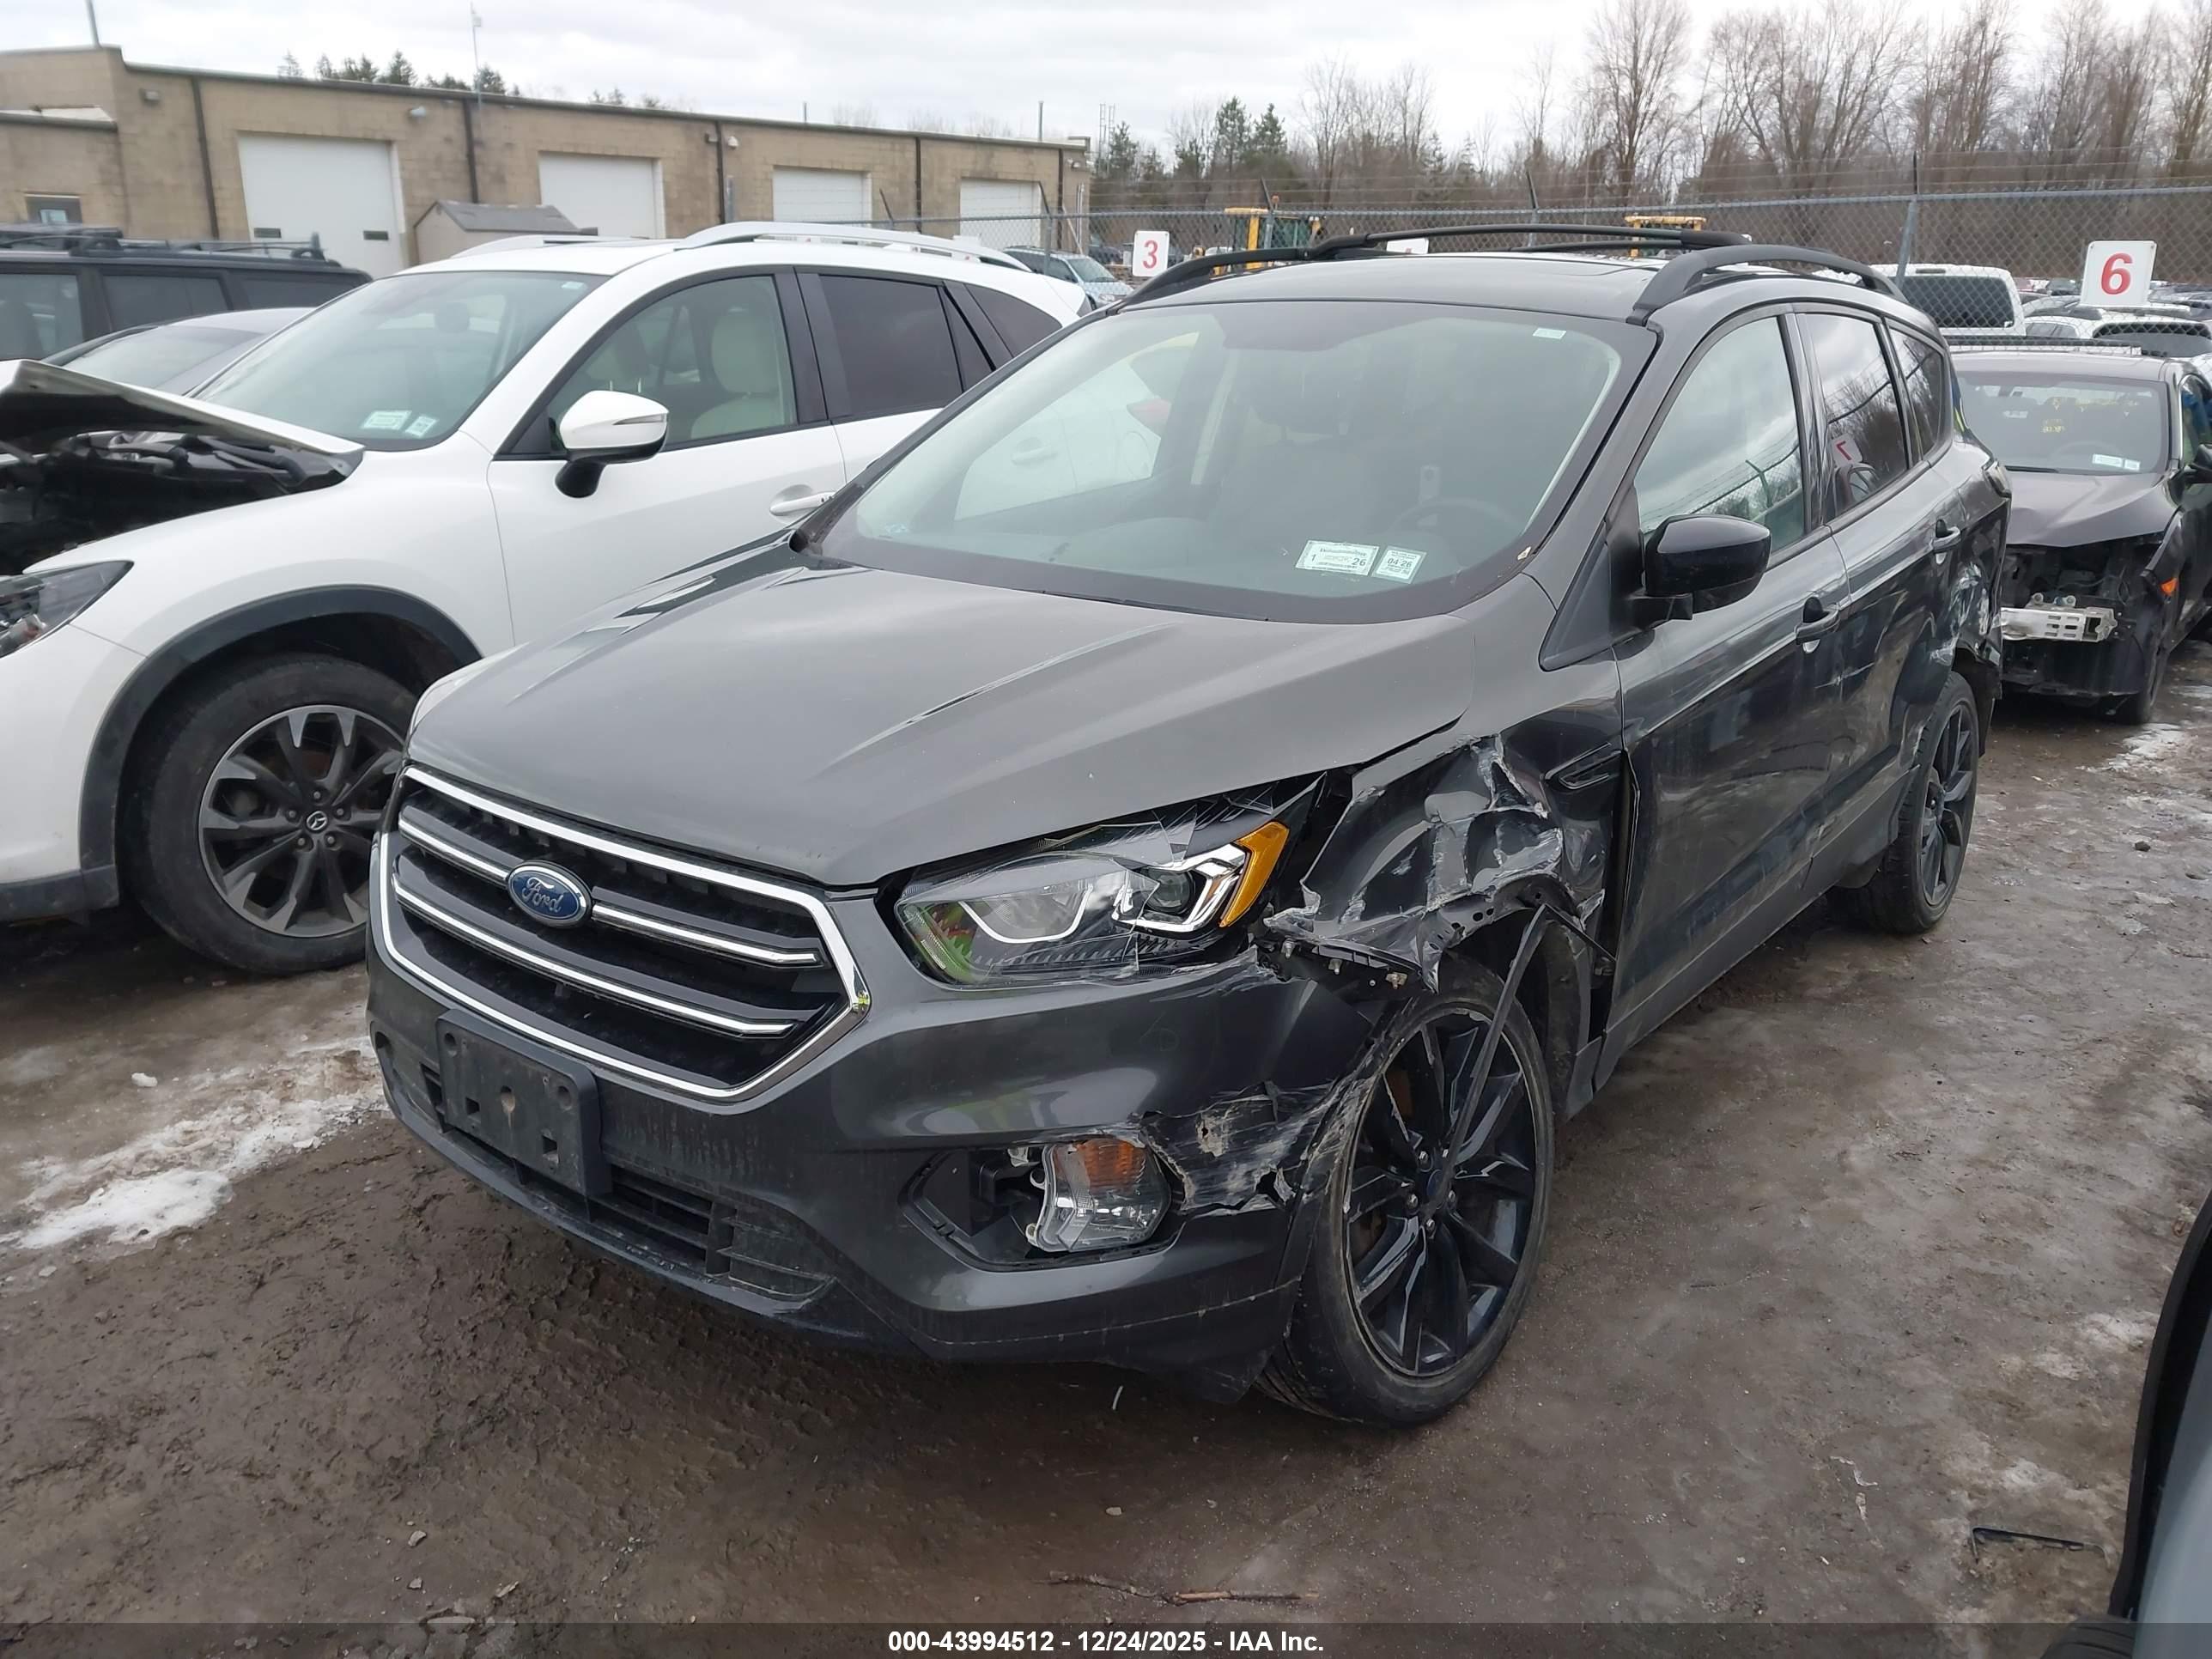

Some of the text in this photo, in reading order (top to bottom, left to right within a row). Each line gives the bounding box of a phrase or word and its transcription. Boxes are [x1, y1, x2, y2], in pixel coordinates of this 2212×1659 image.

[1143, 240, 1158, 270] 3
[2100, 252, 2133, 295] 6
[1351, 557, 1367, 567] 26
[521, 877, 564, 913] Ford
